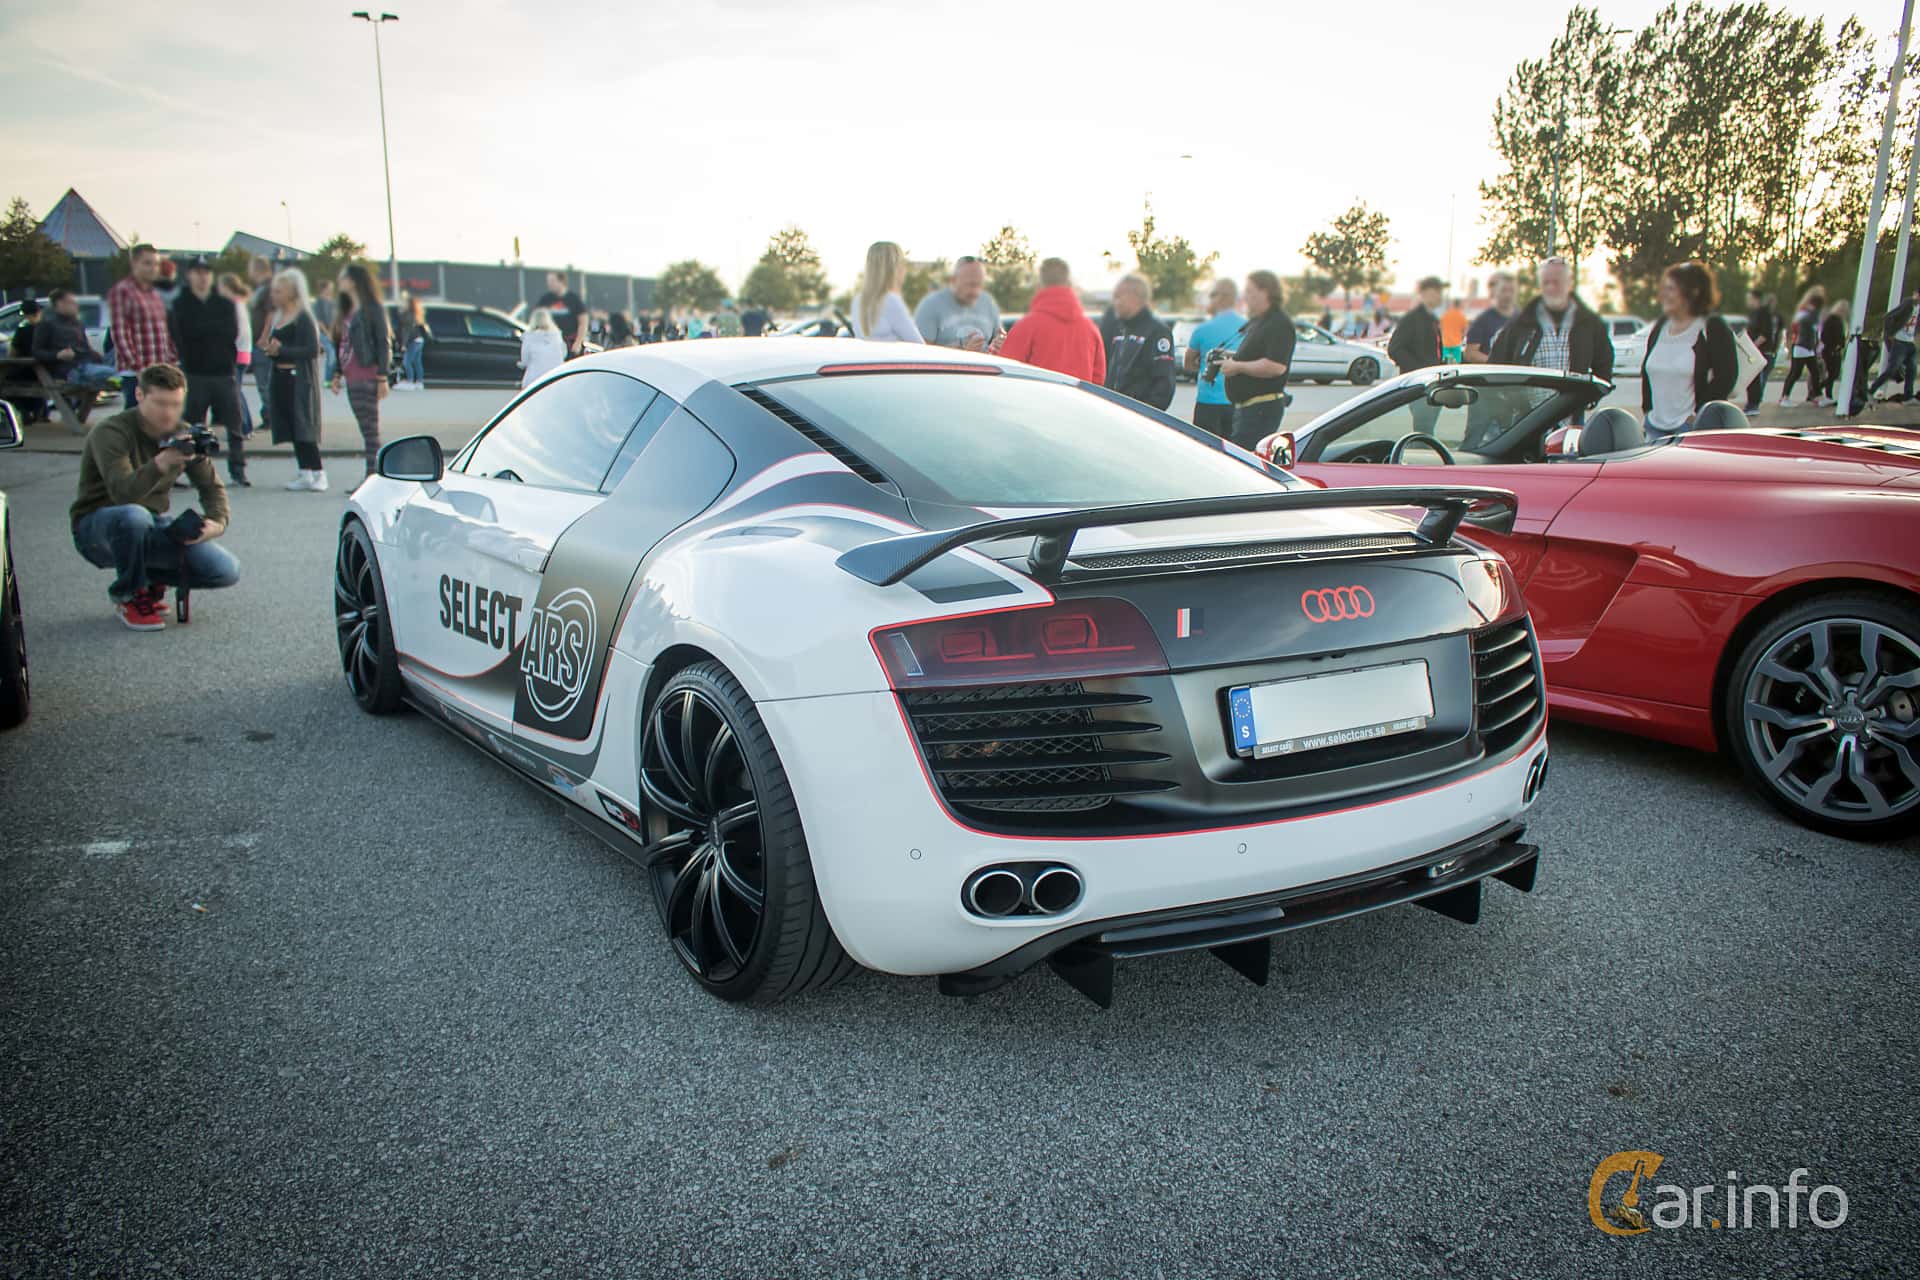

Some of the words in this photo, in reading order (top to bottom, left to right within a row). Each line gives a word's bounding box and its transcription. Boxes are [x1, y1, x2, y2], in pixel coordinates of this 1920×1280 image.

[439, 574, 523, 652] SELECT
[1241, 725, 1250, 739] S
[1302, 727, 1386, 749] www.selectcars.se
